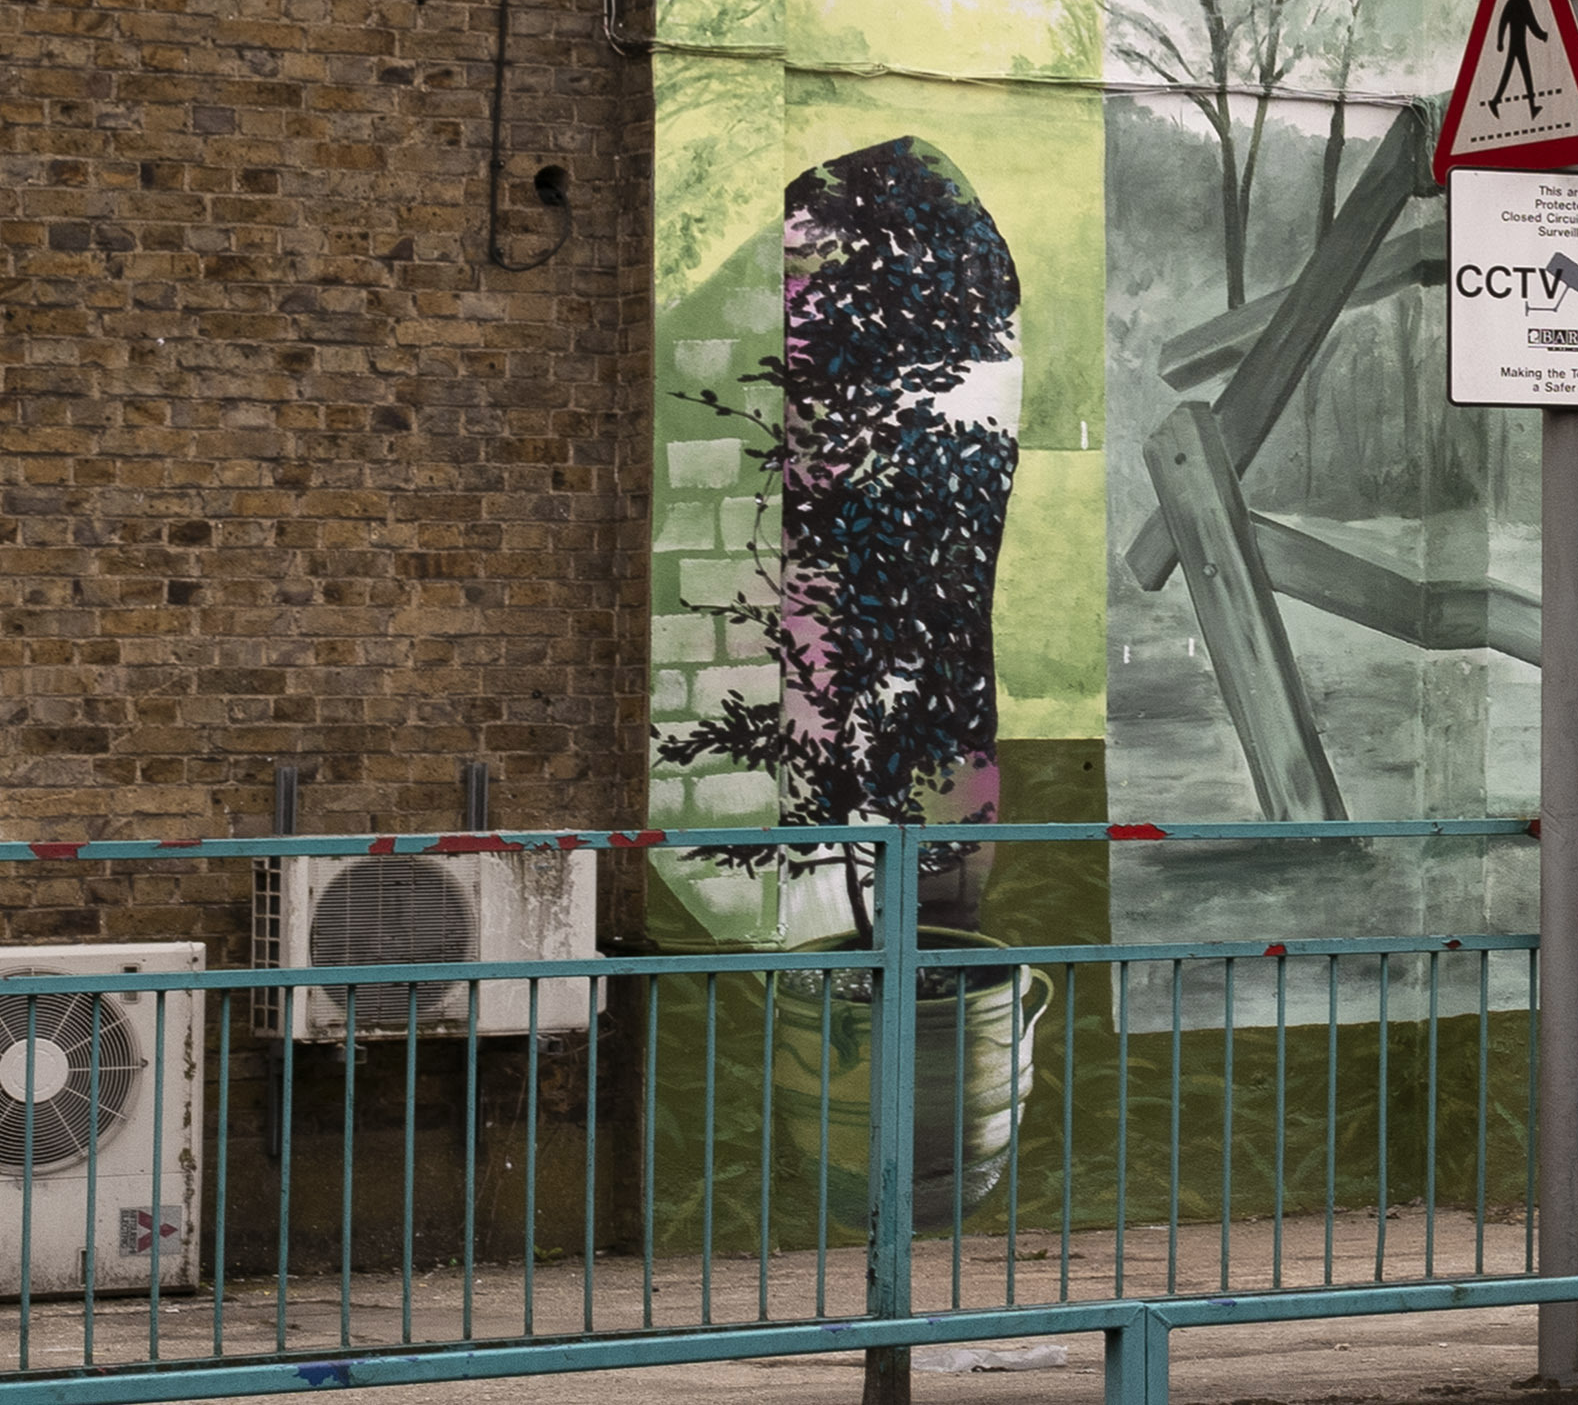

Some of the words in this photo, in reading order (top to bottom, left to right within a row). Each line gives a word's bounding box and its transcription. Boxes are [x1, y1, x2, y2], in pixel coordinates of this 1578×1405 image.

[1539, 185, 1562, 197] This
[1501, 211, 1542, 223] Closed
[1456, 264, 1563, 300] CCTV
[1500, 367, 1542, 380] Making
[1548, 369, 1566, 379] the
[1533, 383, 1540, 392] a
[1545, 382, 1576, 392] Safer
